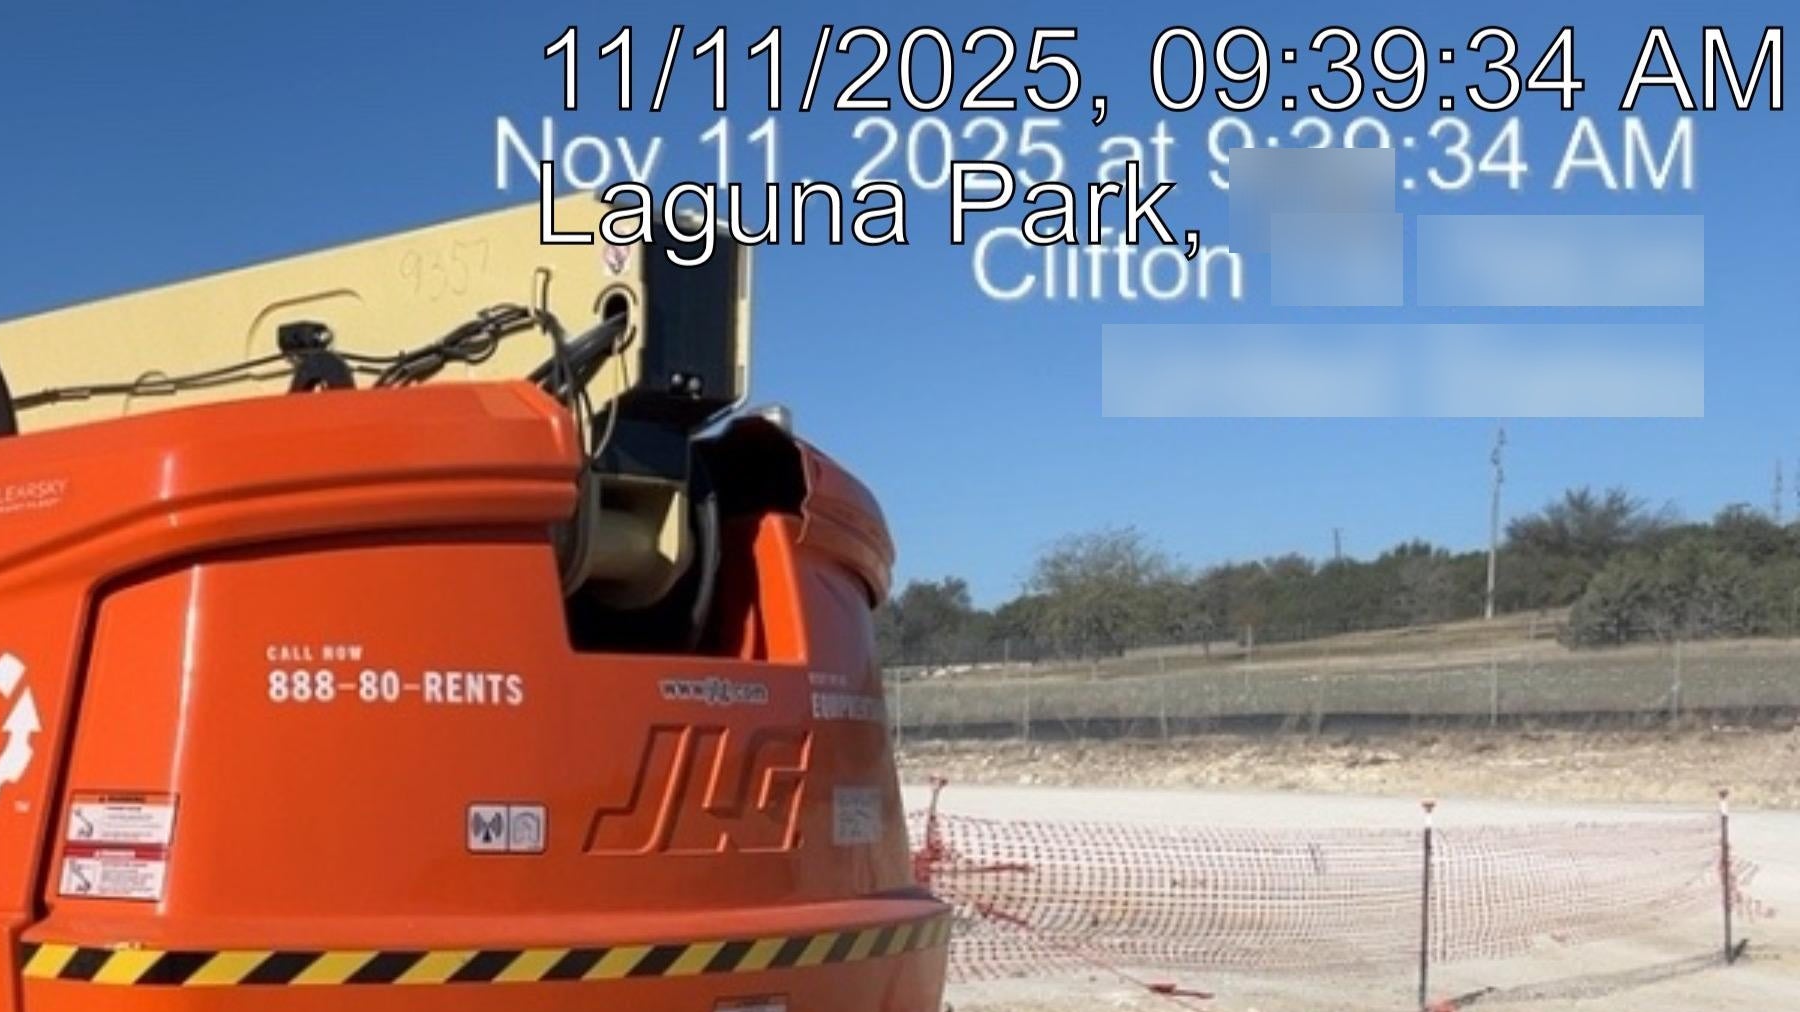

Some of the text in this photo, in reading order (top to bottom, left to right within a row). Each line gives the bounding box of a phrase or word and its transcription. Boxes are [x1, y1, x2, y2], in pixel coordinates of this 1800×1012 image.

[266, 645, 365, 662] CALL NOW
[268, 668, 525, 706] 888-80-RENTS
[582, 725, 814, 856] JLG
